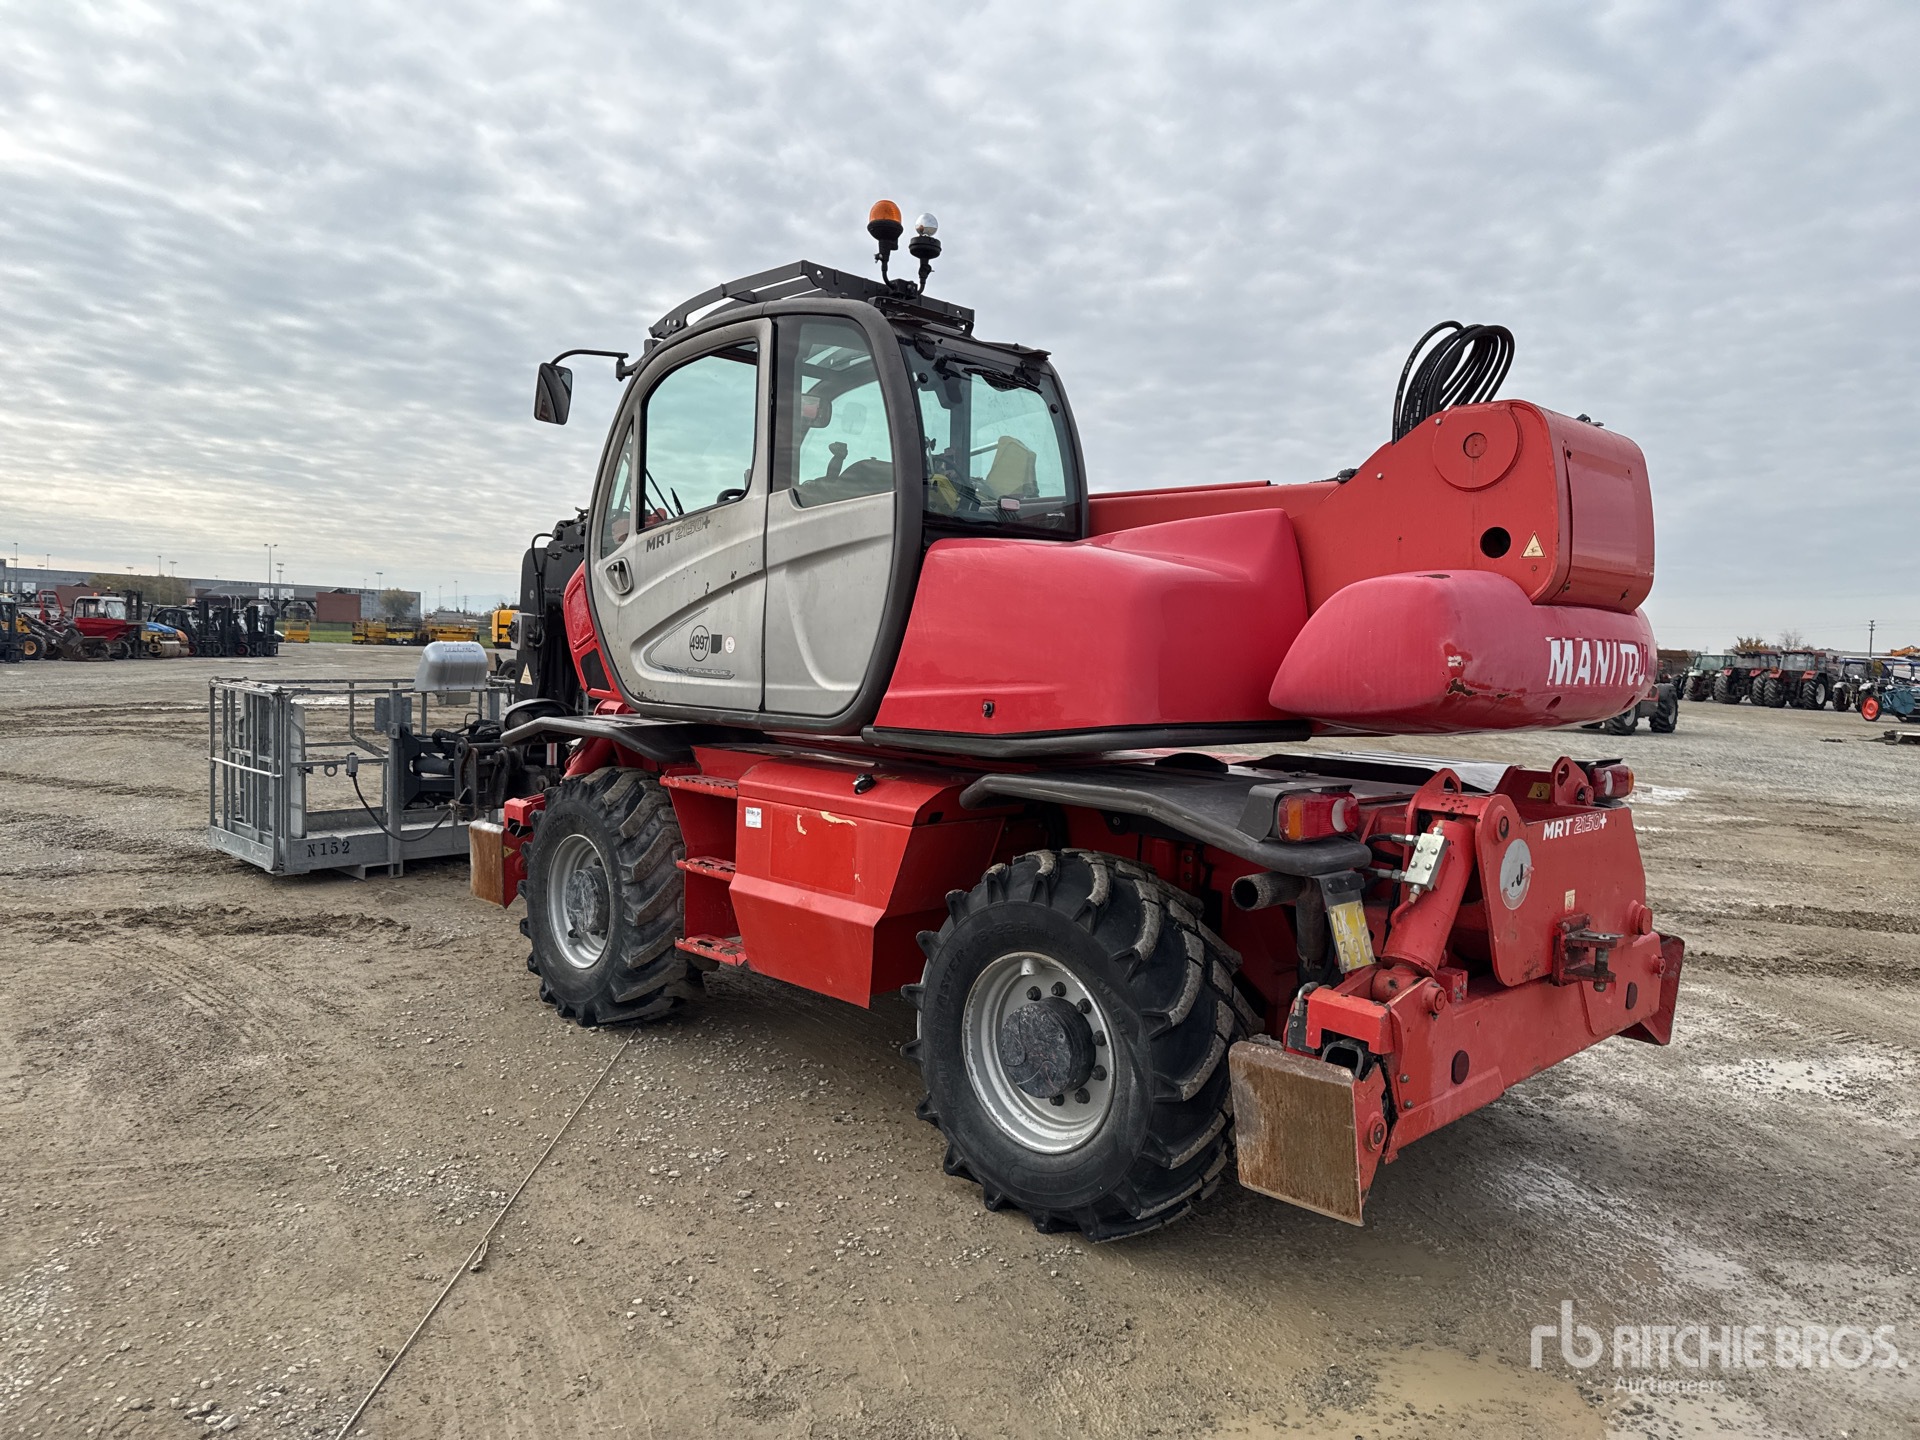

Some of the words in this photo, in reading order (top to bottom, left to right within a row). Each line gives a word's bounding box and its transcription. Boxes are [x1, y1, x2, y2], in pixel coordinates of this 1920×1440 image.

[646, 530, 673, 553] MRT
[690, 635, 710, 652] 4997
[1543, 818, 1573, 841] MRT
